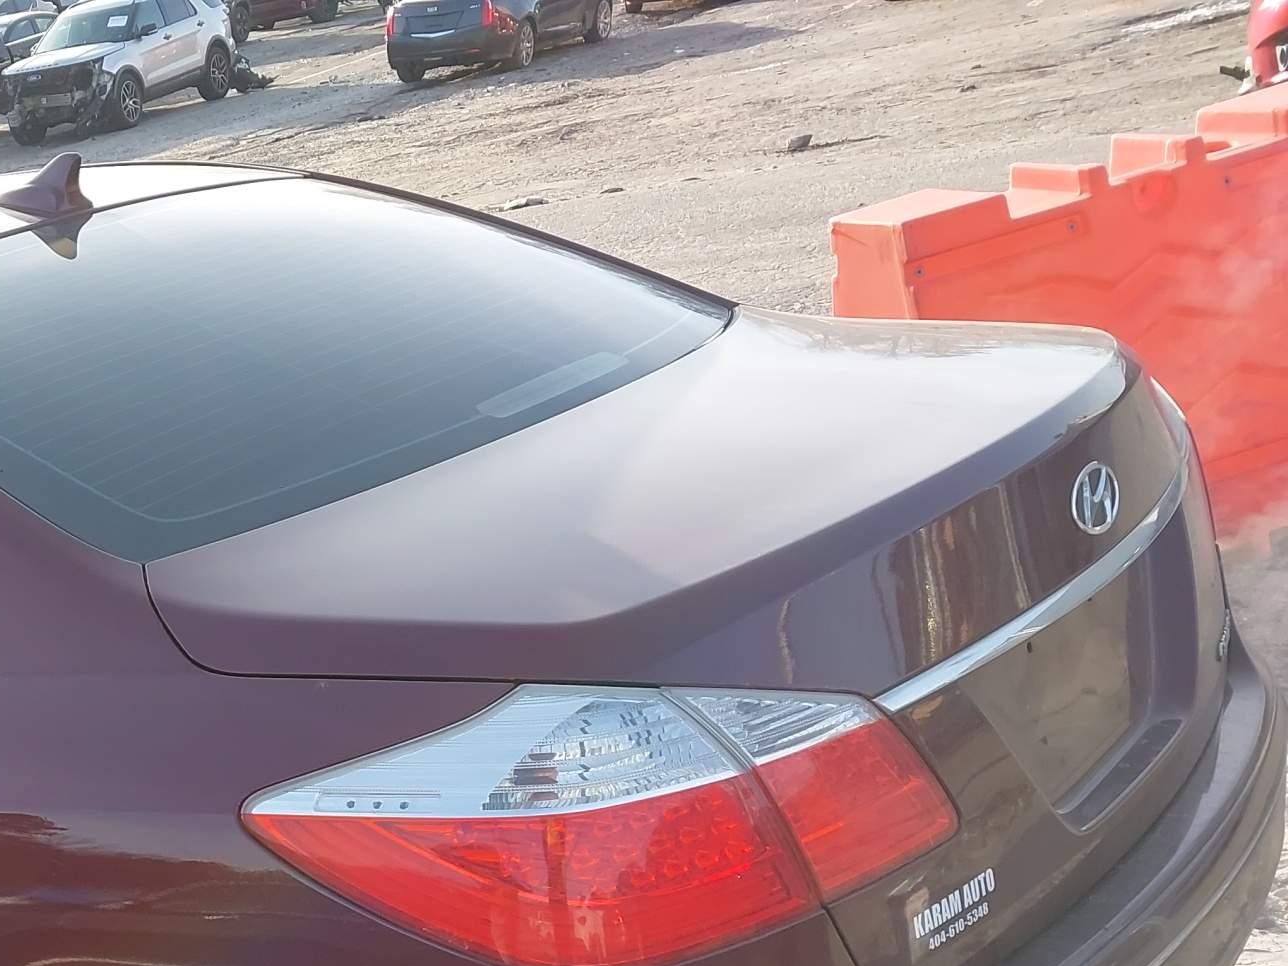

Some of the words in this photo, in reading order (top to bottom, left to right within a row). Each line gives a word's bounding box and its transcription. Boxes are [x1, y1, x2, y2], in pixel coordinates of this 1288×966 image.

[913, 889, 962, 939] KARAM
[962, 867, 996, 908] AUTO
[928, 902, 989, 951] 404-610-5348
